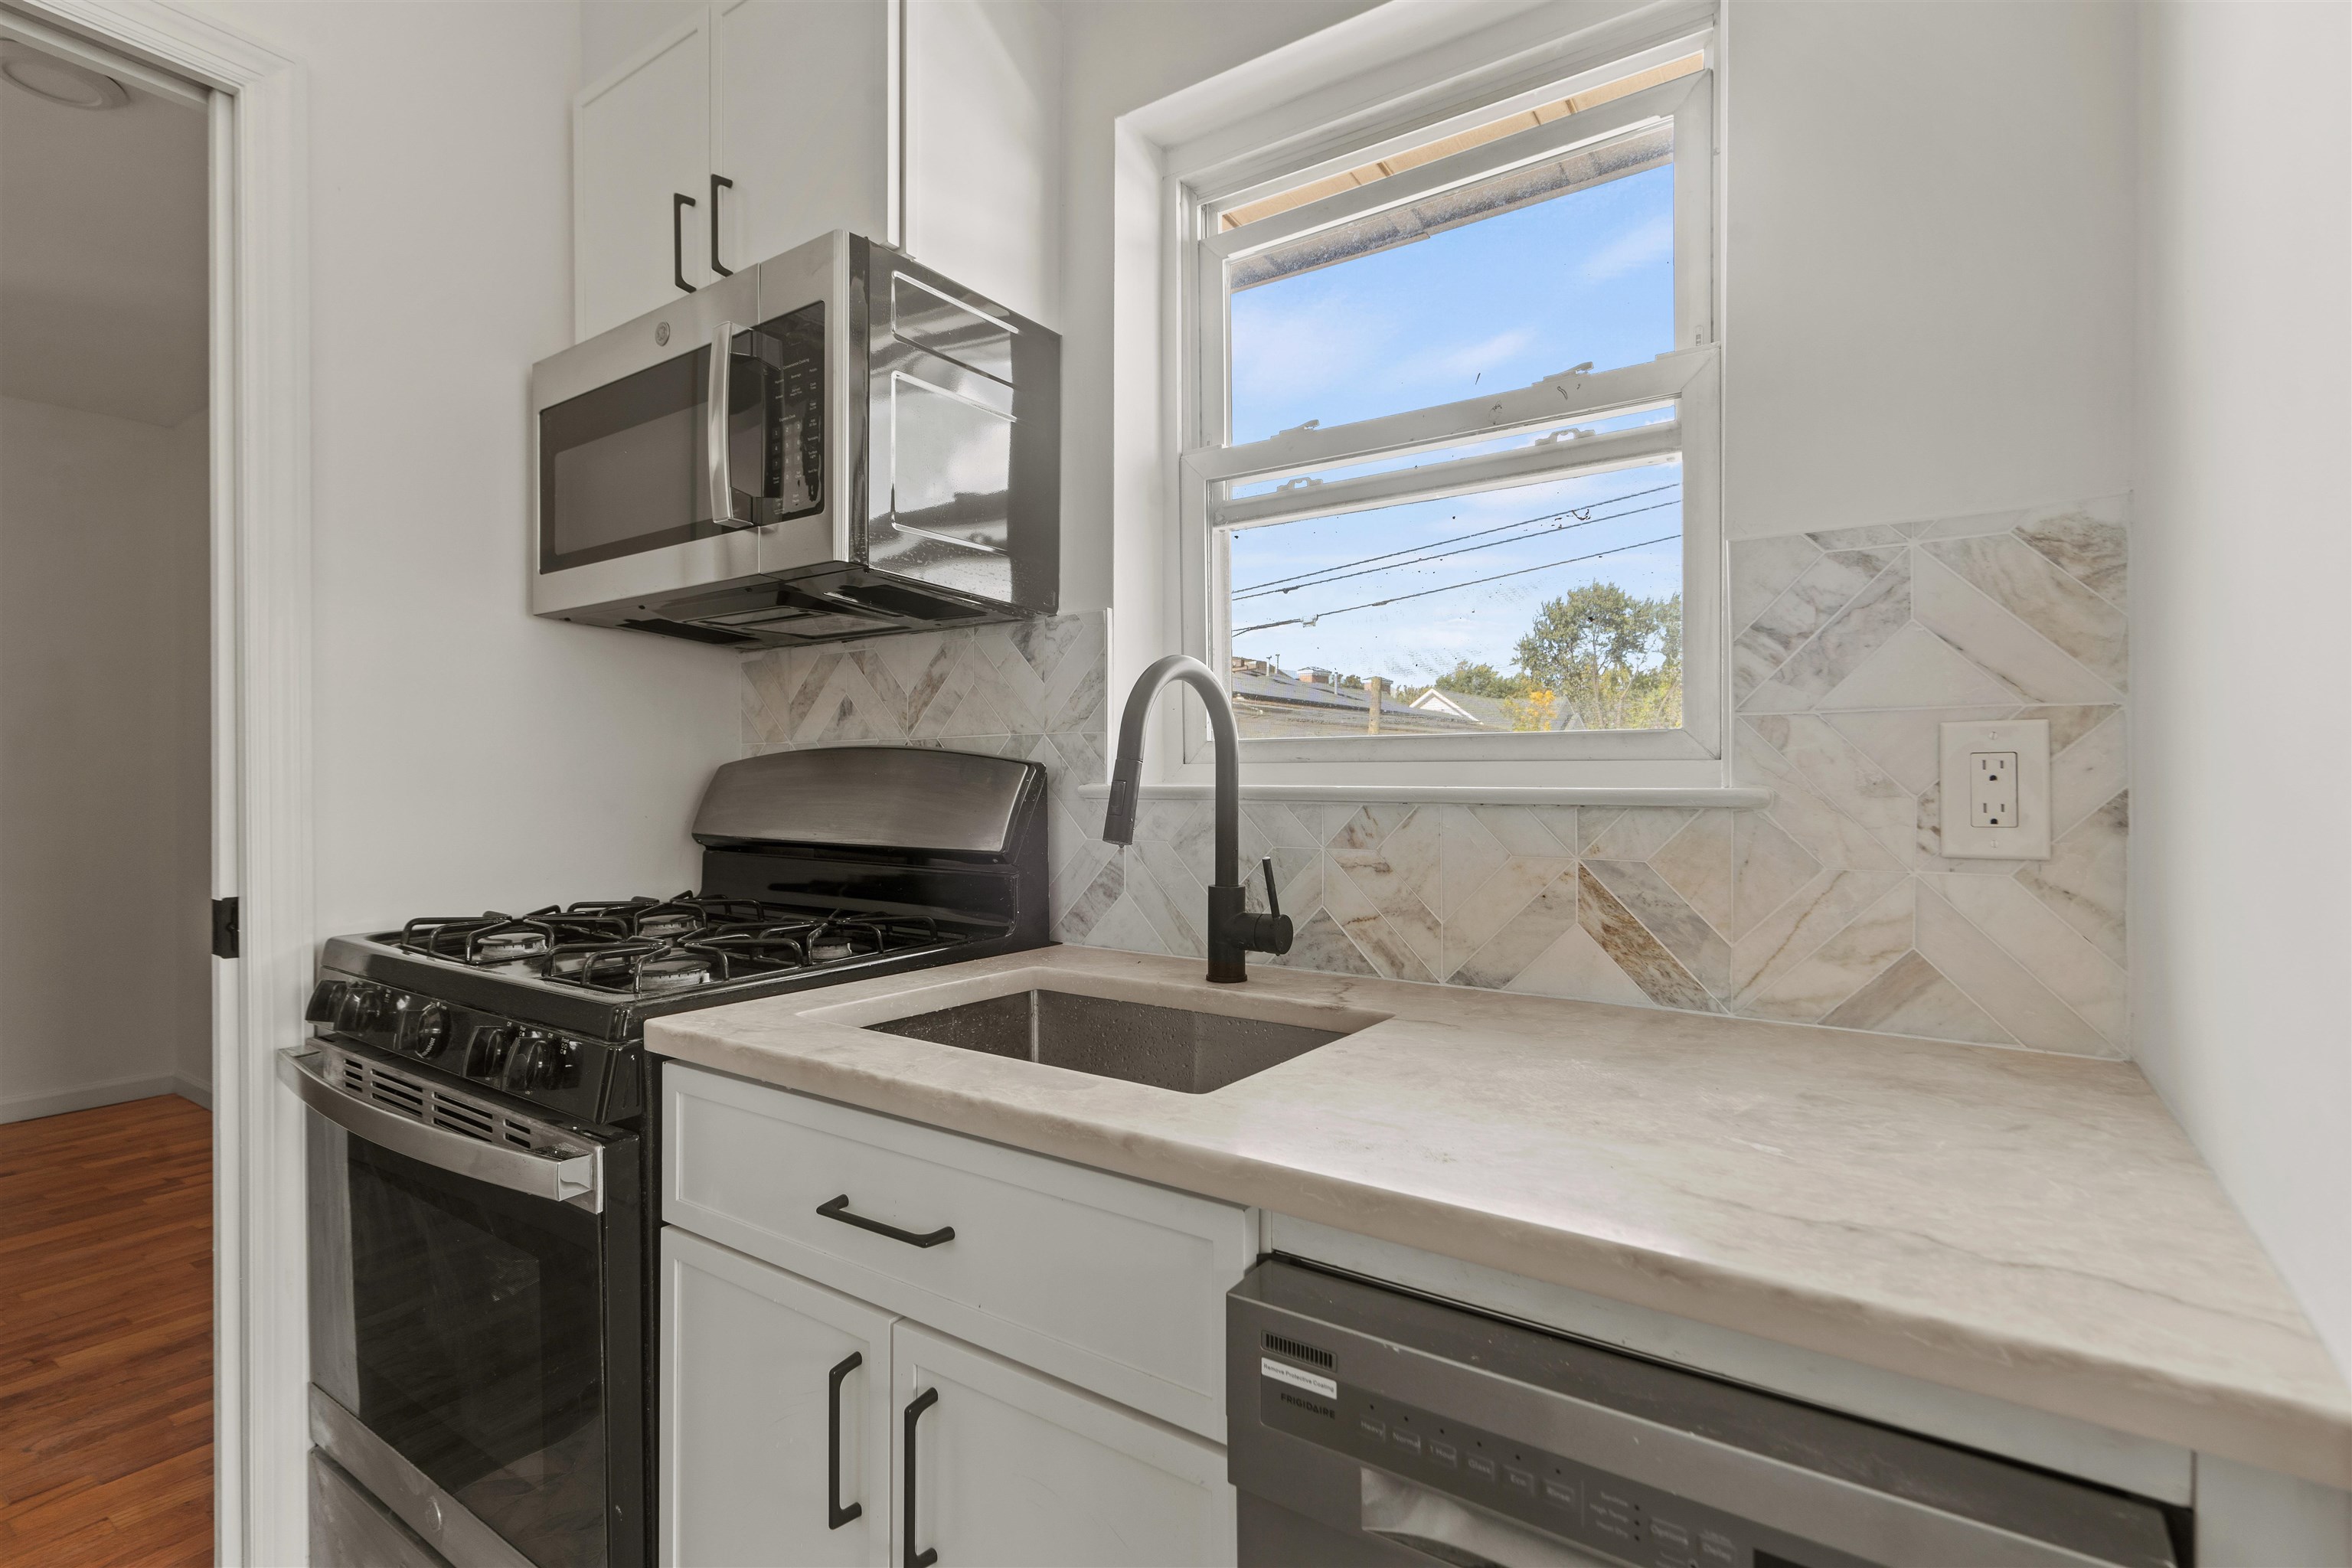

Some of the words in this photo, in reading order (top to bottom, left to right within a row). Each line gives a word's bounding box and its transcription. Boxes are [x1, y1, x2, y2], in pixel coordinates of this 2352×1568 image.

[1263, 1362, 1285, 1376] Remove
[1285, 1370, 1312, 1385] Protective
[1312, 1379, 1334, 1393] Coating
[1280, 1392, 1336, 1420] FRIGIDAIRE
[1360, 1419, 1383, 1438] Heavy
